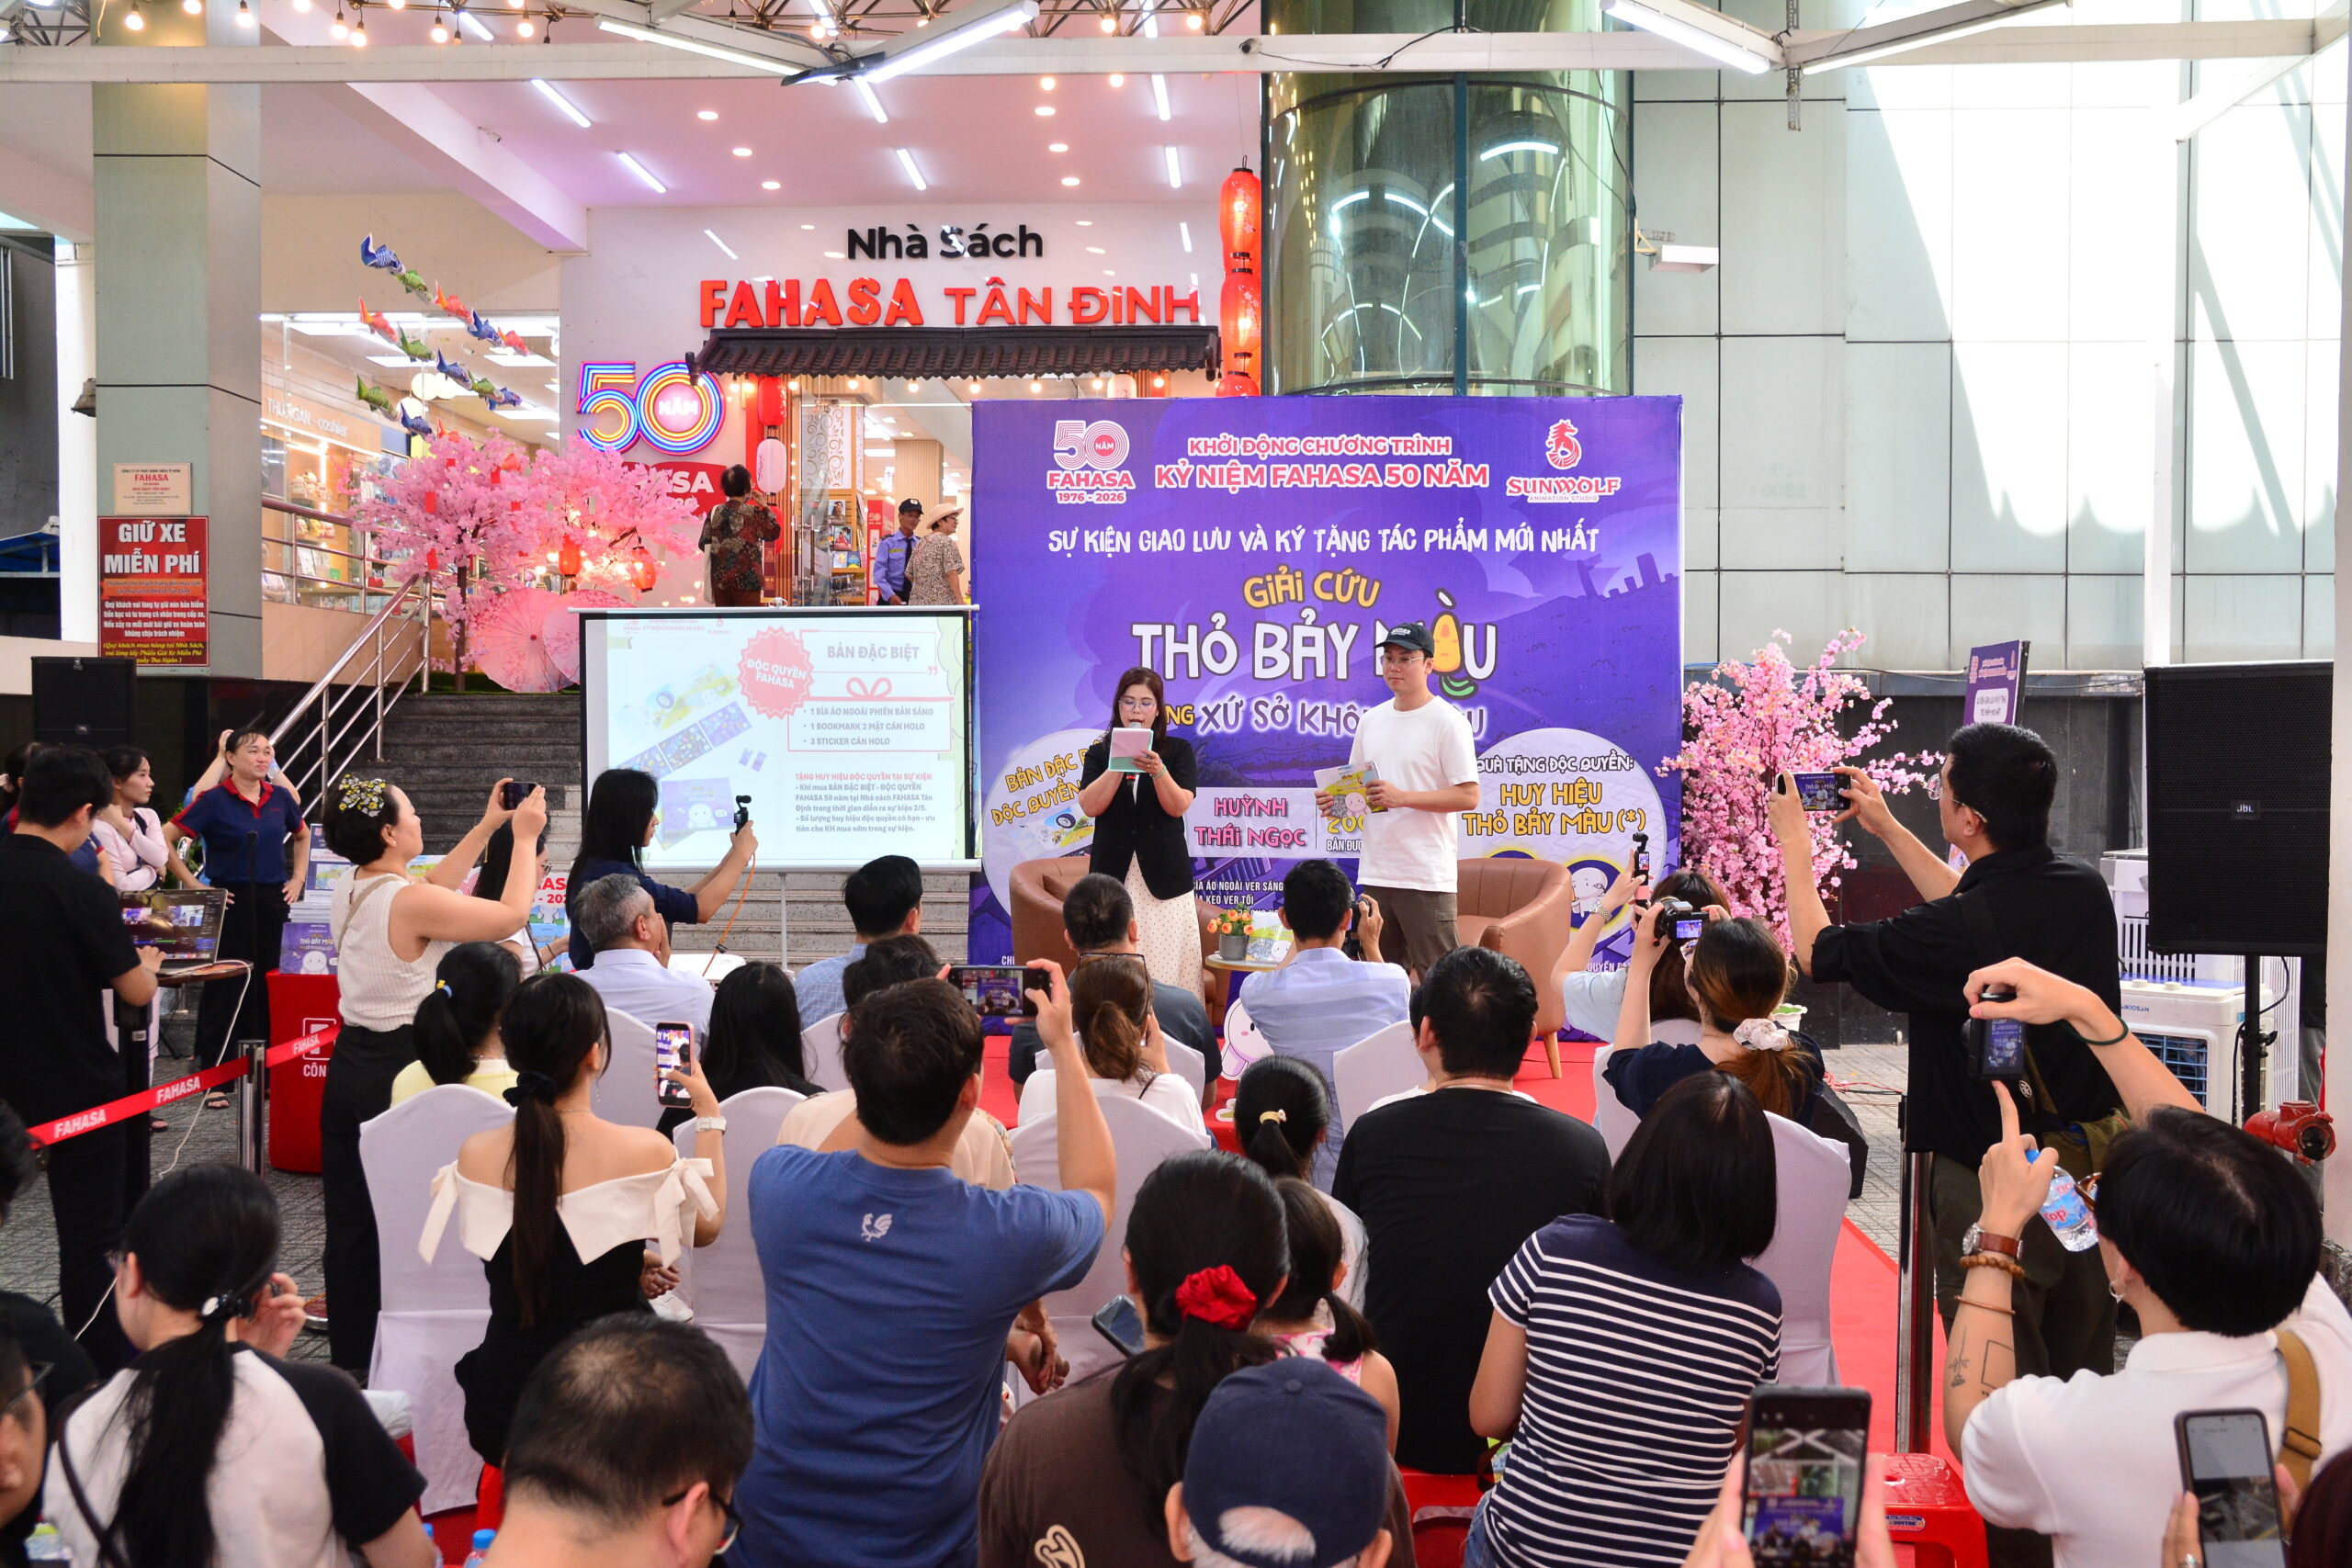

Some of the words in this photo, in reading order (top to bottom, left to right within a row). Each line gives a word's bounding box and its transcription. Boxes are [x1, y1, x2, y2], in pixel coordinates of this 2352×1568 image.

[847, 223, 928, 260] Nhà
[939, 223, 1043, 260] Sách
[700, 277, 924, 327] FAHASA
[944, 277, 1052, 325] TÂN
[576, 359, 726, 456] 50
[657, 396, 699, 416] NĂM
[1054, 420, 1130, 471] 50
[1094, 440, 1114, 450] NĂM
[1189, 433, 1238, 456] KHỞI
[1241, 434, 1298, 458] ĐỘNG
[1302, 434, 1388, 455] CHƯƠNG
[1391, 434, 1451, 455] TRÌNH
[1047, 471, 1136, 489] FAHASA
[1156, 459, 1195, 488] KỶ
[1197, 459, 1266, 493] NIỆM
[1271, 464, 1383, 488] FAHASA
[1385, 464, 1422, 488] 50
[1425, 459, 1489, 488] NĂM
[1507, 477, 1621, 497] SUNWOLF
[1057, 491, 1085, 503] 1976
[1096, 491, 1125, 503] 2026
[119, 520, 156, 542] GIỮ
[159, 524, 187, 542] XE
[1048, 526, 1080, 558] SỰ
[1084, 525, 1131, 558] KIỆN
[1138, 528, 1185, 552] GIAO
[1193, 526, 1231, 552] LƯU
[1239, 524, 1268, 552] VÀ
[1275, 525, 1306, 552] KÝ
[1314, 524, 1370, 558] TẶNG
[1378, 524, 1417, 552] TÁC
[1425, 517, 1487, 552] PHẨM
[1495, 522, 1533, 552] MỚI
[1542, 517, 1600, 552] NHẤT
[104, 547, 159, 573] MIỄN
[164, 551, 200, 573] PHÍ
[1313, 567, 1380, 608] CỨU
[827, 642, 855, 659] BẢN
[858, 644, 887, 661] ĐẶC
[890, 644, 920, 661] BIỆT
[1132, 612, 1238, 681] THỎ
[1252, 608, 1359, 682] BẢY
[747, 659, 770, 672] ĐỘC
[771, 662, 808, 681] QUYỀN
[755, 671, 795, 689] FAHASA
[810, 707, 815, 716] 1
[816, 705, 830, 716] BÌA
[831, 705, 842, 716] ÁO
[842, 705, 868, 716] NGOÀI
[869, 705, 894, 716] PHIÊN
[895, 705, 910, 716] BẢN
[912, 705, 933, 716] SÁNG
[1199, 695, 1243, 732] XỨ
[1254, 694, 1292, 730] SỞ
[869, 722, 884, 732] MẶT
[886, 721, 902, 730] CÁN
[851, 736, 867, 745] CÁN
[1005, 765, 1044, 793] BẢN
[1044, 753, 1078, 778] ĐẶC
[1477, 755, 1503, 772] QUÀ
[1506, 755, 1546, 775] TẶNG
[1548, 755, 1577, 773] ĐỘC
[1579, 750, 1634, 773] QUYỀN:
[796, 773, 814, 781] TẶNG
[815, 773, 831, 781] HUY
[831, 773, 849, 781] HIỆU
[850, 773, 865, 781] ĐỘC
[866, 772, 890, 781] QUYỀN
[892, 773, 902, 781] TẠI
[904, 773, 915, 781] SỰ
[916, 773, 933, 781] KIỆN
[991, 801, 1026, 827] ĐỘC
[1027, 778, 1081, 814] QUYỀN
[1500, 783, 1545, 807] HUY
[1552, 777, 1602, 807] HIỆU
[1214, 794, 1287, 818] HUỲNH
[1462, 809, 1509, 835] THỎ
[1514, 807, 1555, 835] BẢY
[1561, 807, 1613, 835] MÀU
[1247, 827, 1306, 848] NGỌC
[1327, 837, 1344, 852] BẢN
[1193, 880, 1204, 891] ÌA
[1206, 880, 1216, 891] ÁO
[1218, 880, 1242, 891] NGOÀI
[1245, 882, 1261, 891] VER
[1262, 880, 1283, 891] SÁNG
[1205, 895, 1221, 905] KEO
[1224, 895, 1239, 905] VER
[1241, 893, 1254, 905] TỐI
[293, 1033, 321, 1055] FAHASA
[156, 1077, 200, 1103] FAHASA
[54, 1109, 107, 1139] FAHASA
